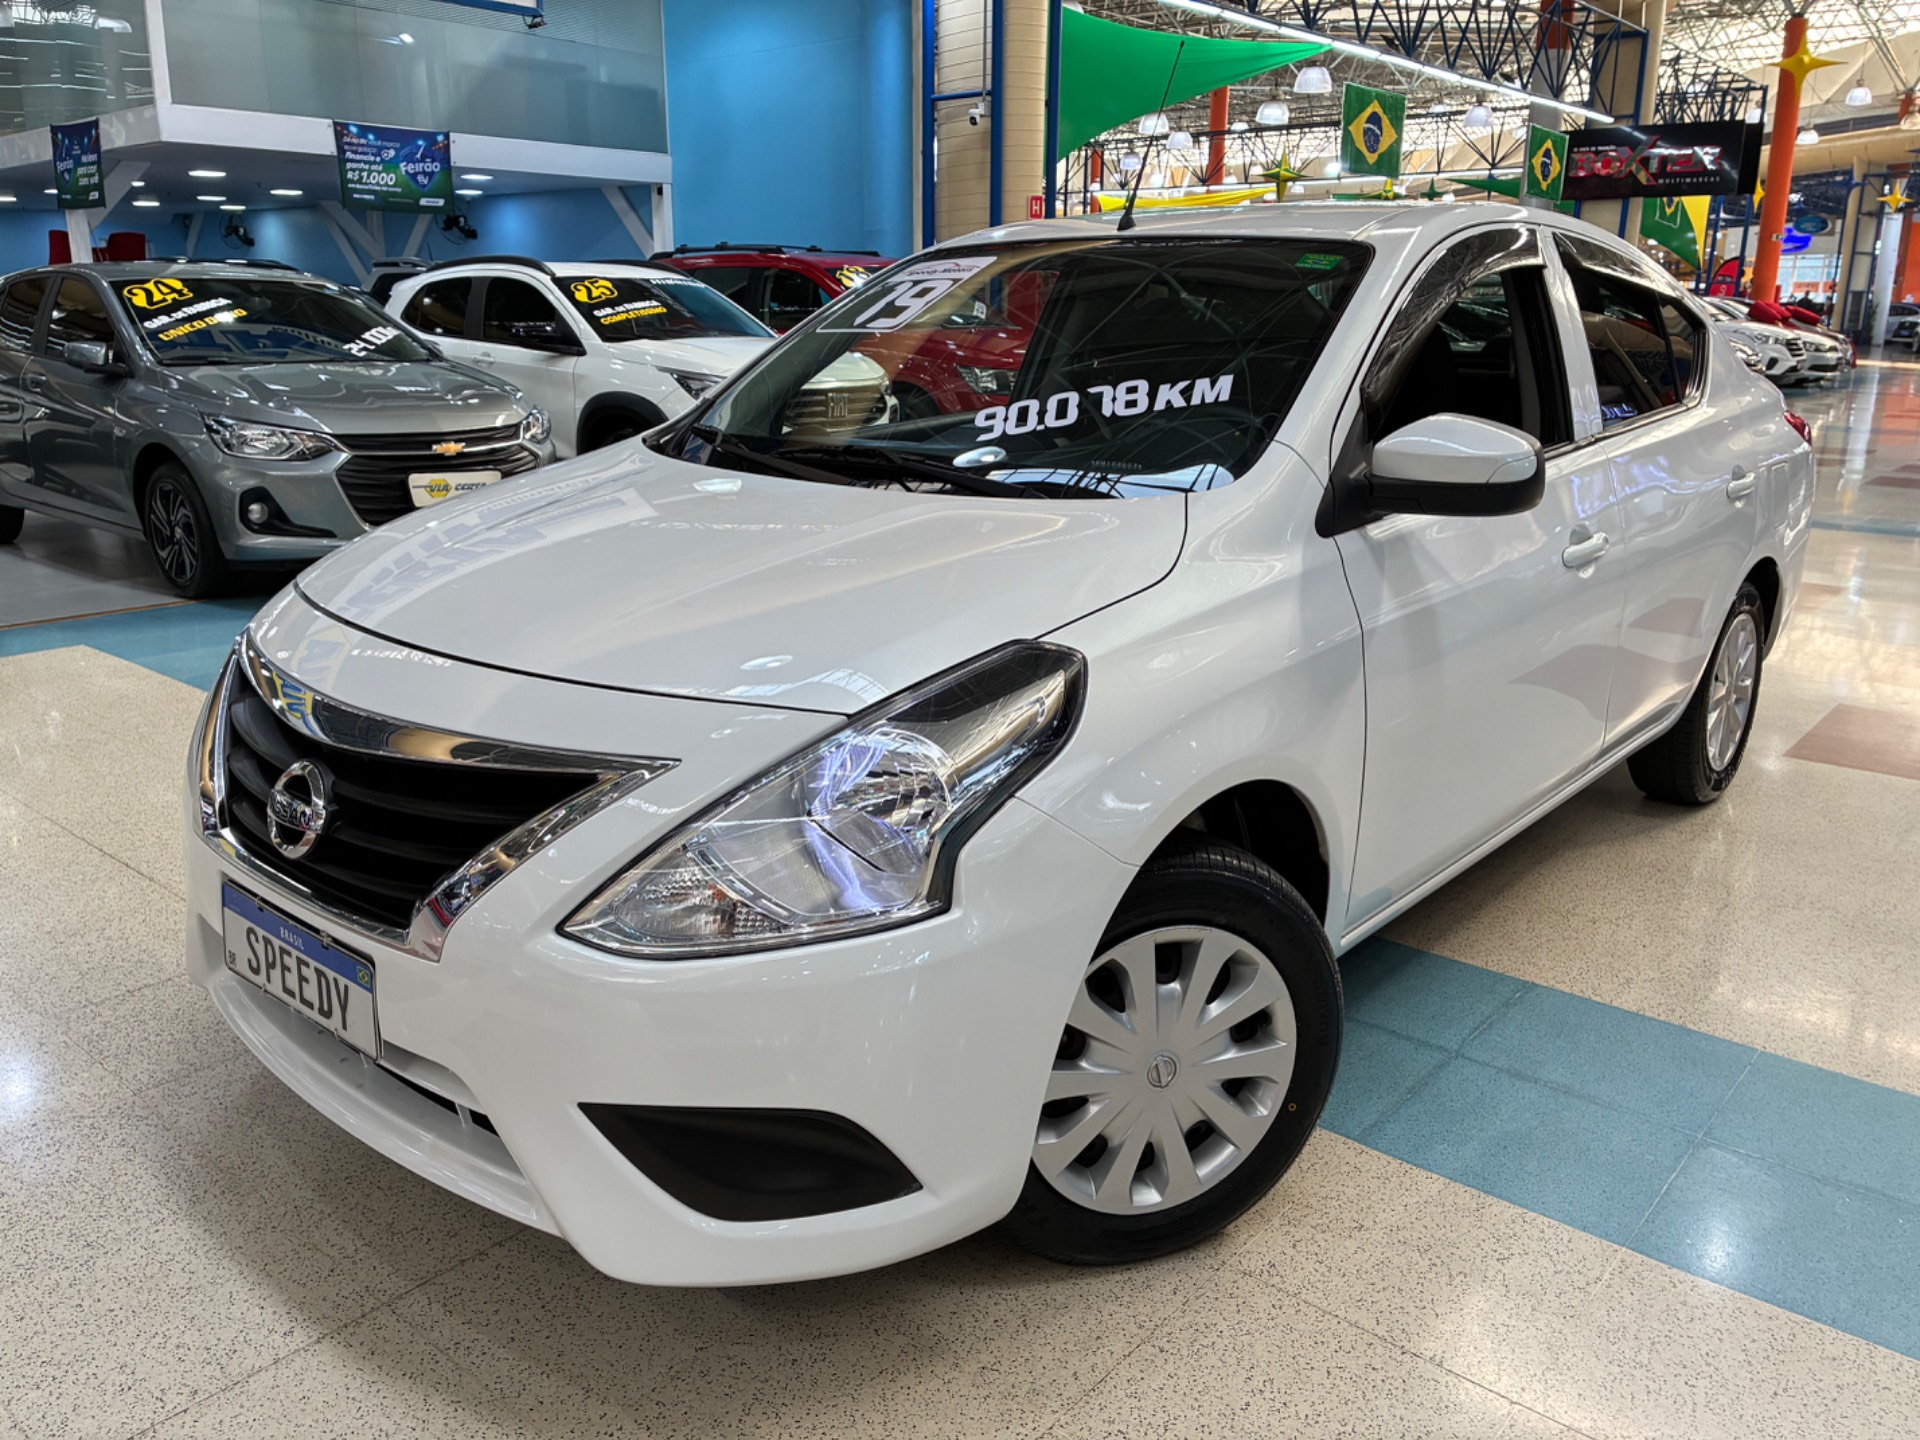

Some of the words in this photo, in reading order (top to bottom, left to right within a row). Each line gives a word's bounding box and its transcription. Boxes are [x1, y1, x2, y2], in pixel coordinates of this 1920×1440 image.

[399, 159, 441, 175] Feirão
[346, 171, 360, 181] R$
[361, 171, 397, 185] 1.000
[1657, 176, 1721, 185] MULTIMARCAS
[1032, 199, 1040, 215] H
[123, 278, 194, 309] 24
[570, 278, 618, 304] 25
[853, 278, 955, 329] 19
[1153, 374, 1235, 412] KM
[429, 482, 450, 493] VIA
[279, 926, 305, 950] BRASIL
[227, 949, 238, 968] BR
[245, 926, 349, 1032] SPEEDY
